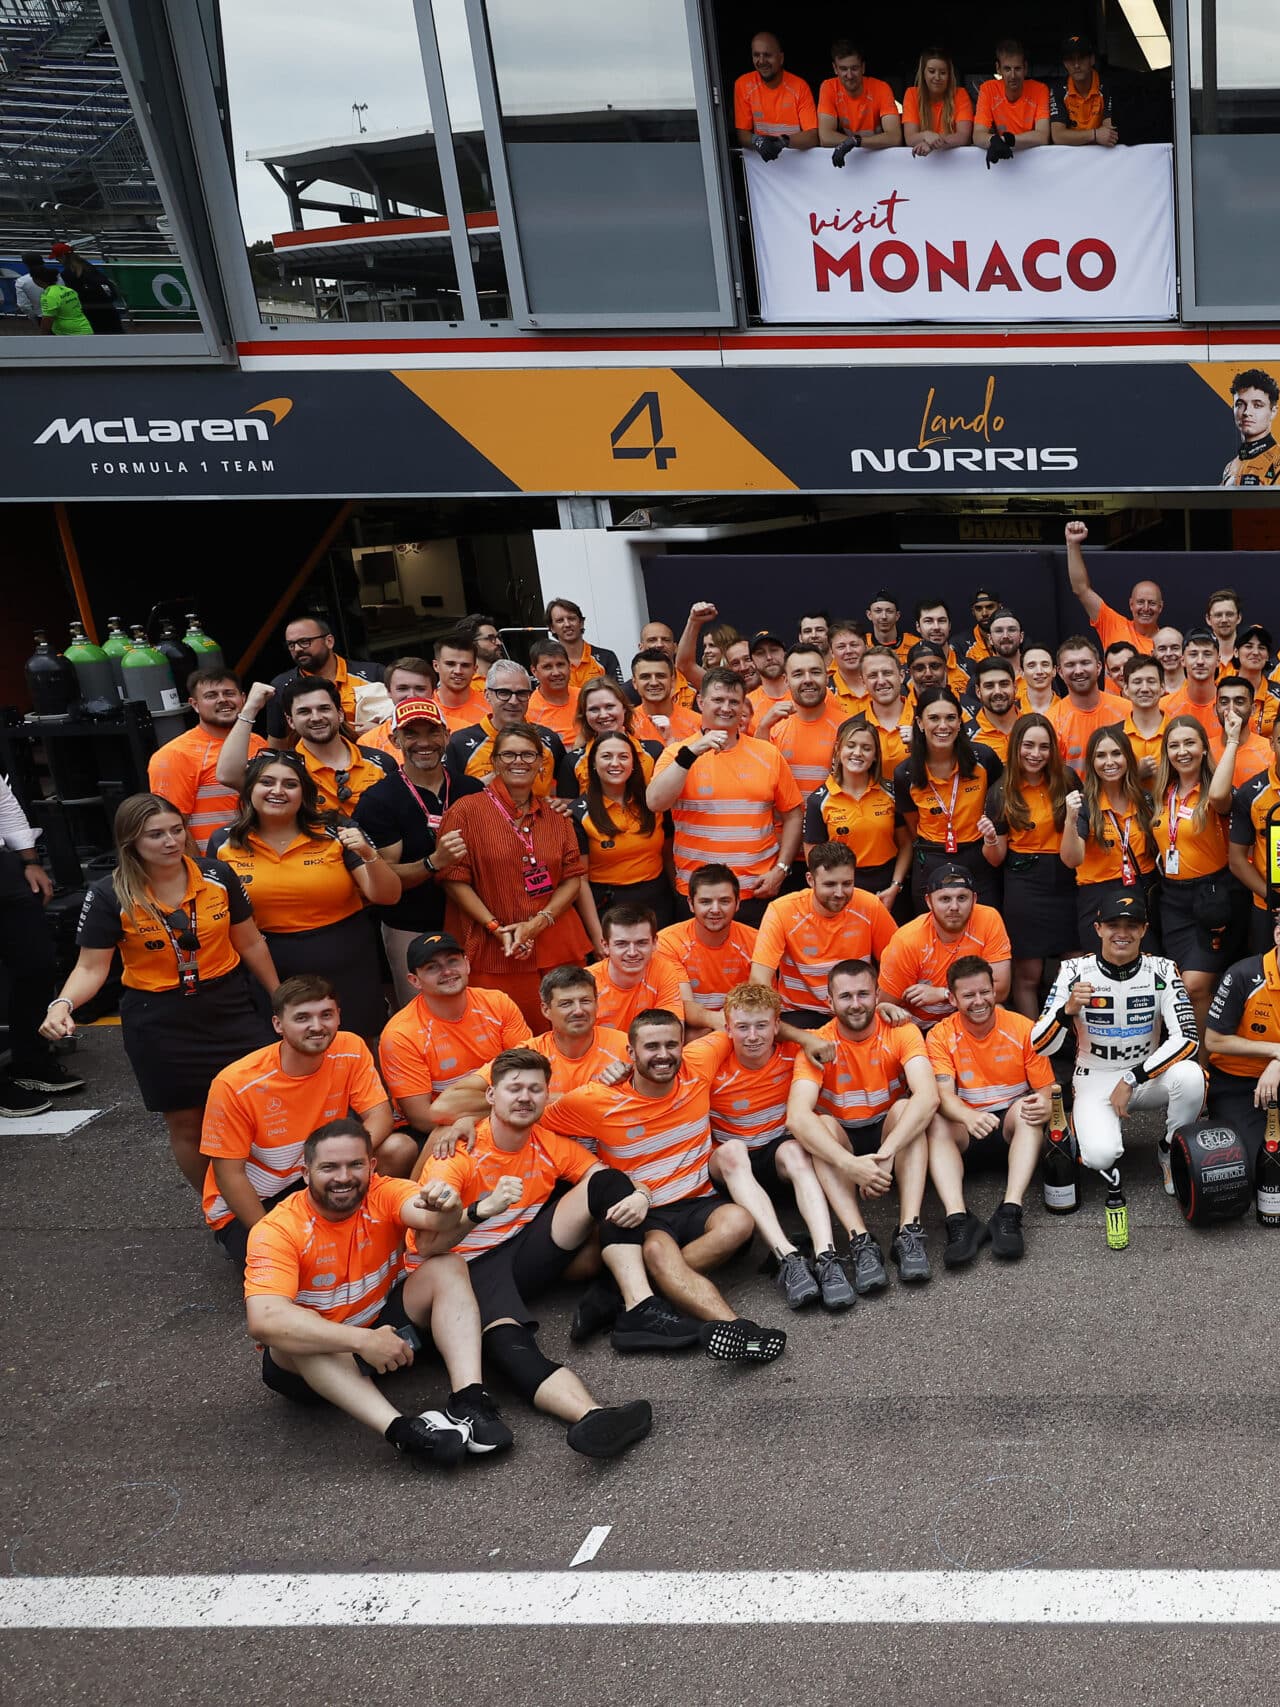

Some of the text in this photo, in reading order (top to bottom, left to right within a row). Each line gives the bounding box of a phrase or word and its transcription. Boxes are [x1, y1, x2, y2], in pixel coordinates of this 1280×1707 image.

[809, 190, 911, 236] visit
[812, 238, 1117, 293] MONACO
[33, 416, 271, 445] McLaren
[610, 391, 677, 470] 4
[917, 376, 1005, 449] Lando
[91, 460, 275, 474] FORMULA 1 TEAM
[850, 446, 1079, 473] NORRIS
[1090, 1041, 1151, 1060] OKX
